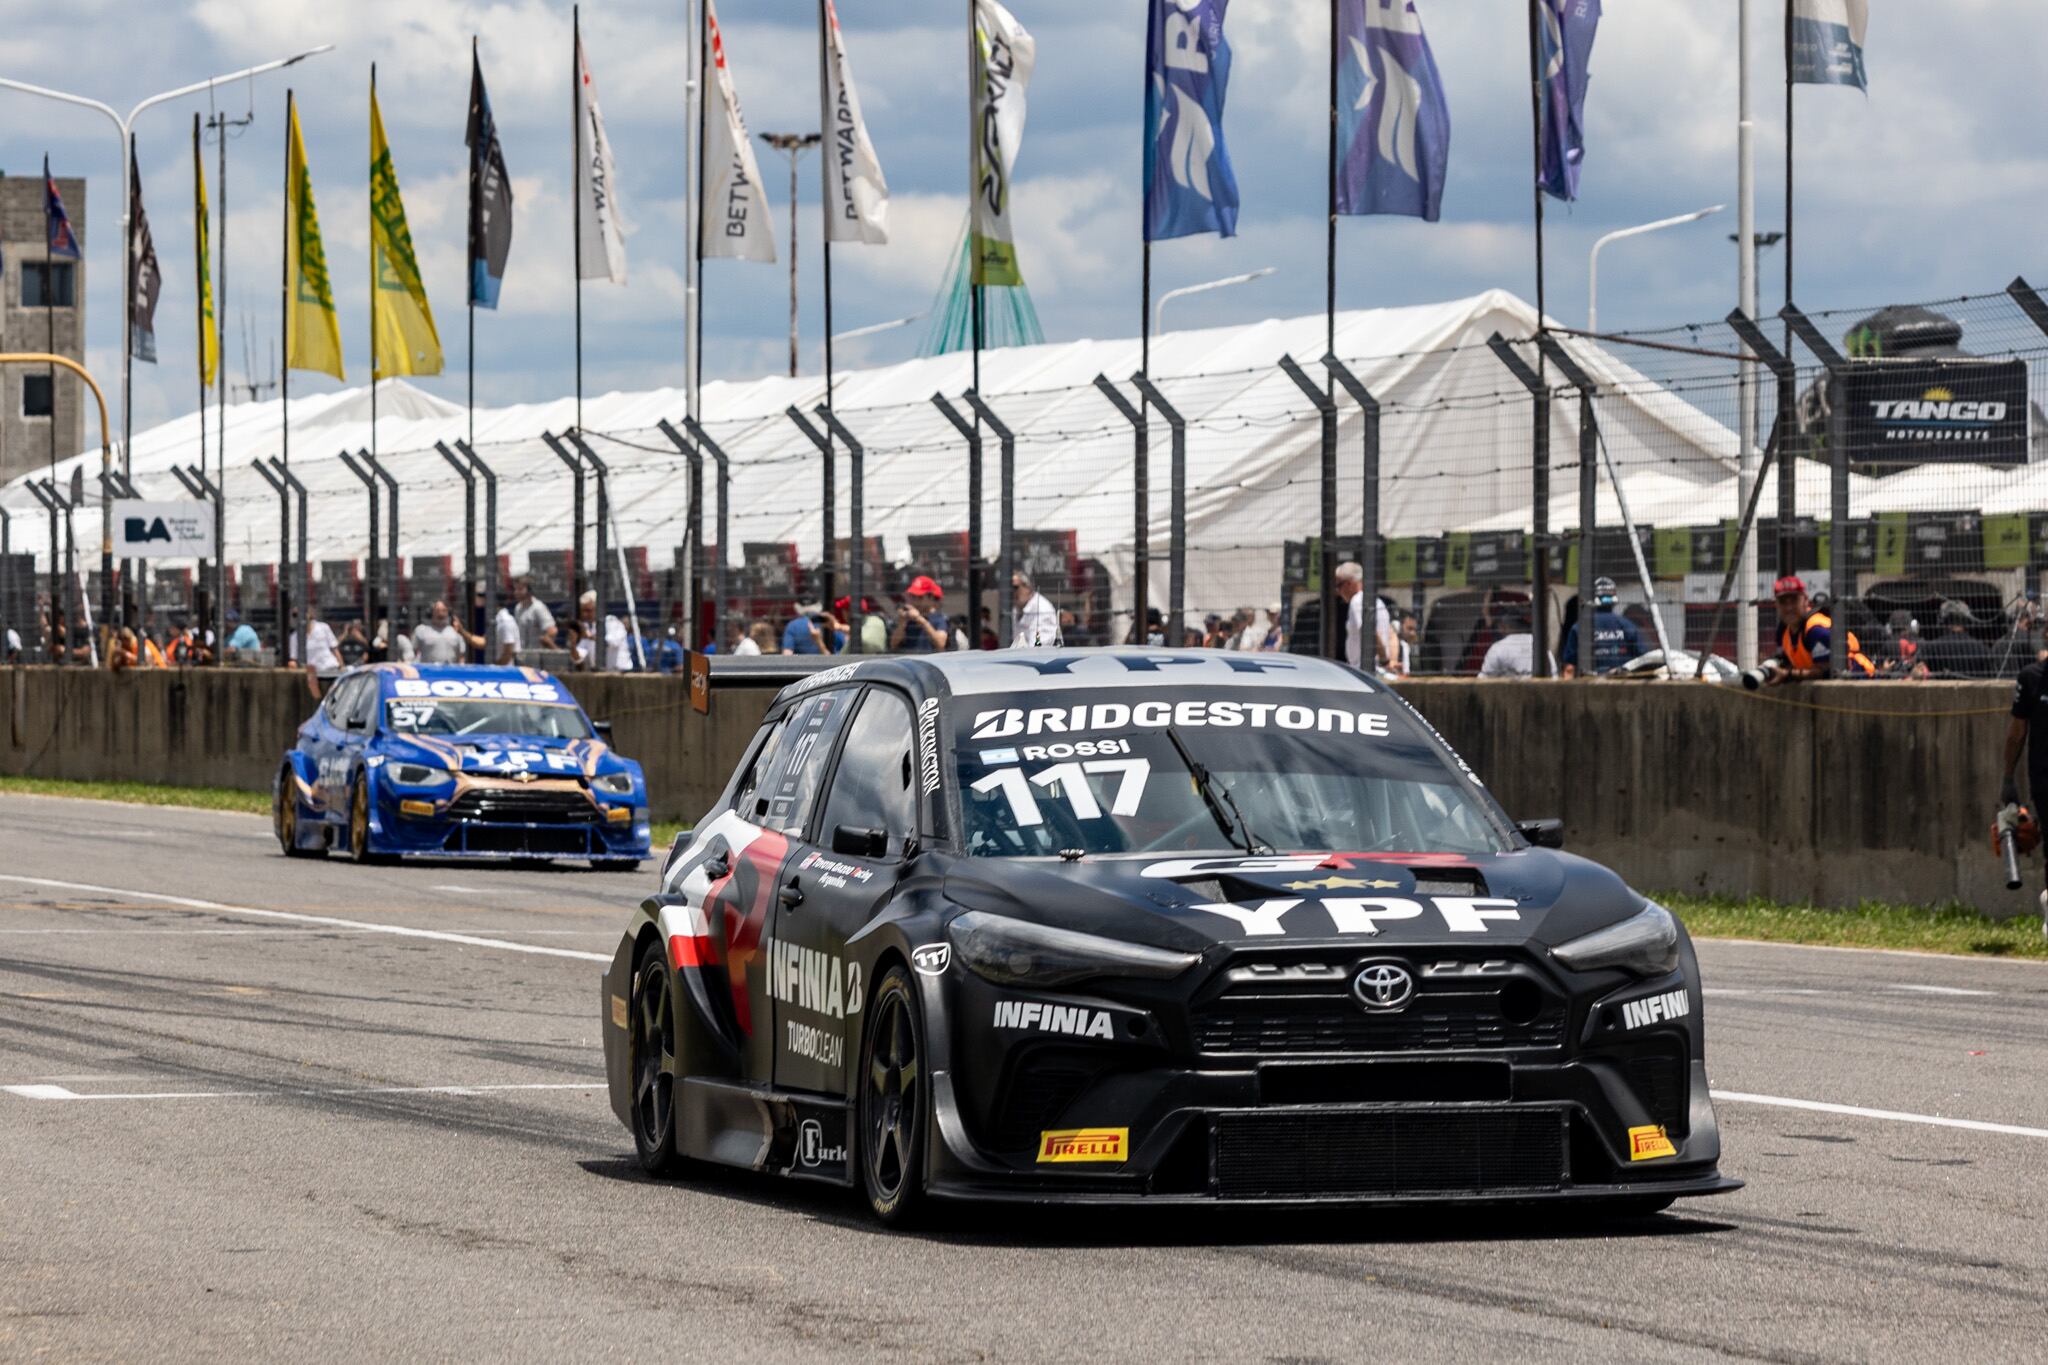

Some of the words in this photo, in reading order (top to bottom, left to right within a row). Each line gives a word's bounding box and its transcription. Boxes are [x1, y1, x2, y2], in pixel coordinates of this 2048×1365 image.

[1868, 400, 2007, 421] TANGO
[1886, 429, 1990, 442] MOTORSPORTS
[124, 516, 172, 543] BA
[996, 655, 1297, 675] YPF
[394, 680, 560, 701] BOXES
[391, 707, 435, 727] 57
[969, 701, 1391, 740] BRIDGESTONE
[464, 751, 579, 770] YPF
[785, 732, 820, 776] 117
[1022, 738, 1131, 761] ROSSI
[969, 757, 1152, 827] 117
[1188, 897, 1521, 936] YPF
[914, 948, 948, 967] 117
[765, 936, 844, 1020] INFINIA
[993, 1001, 1115, 1040] INFINIA
[1622, 988, 1690, 1031] INFINI
[1044, 1134, 1121, 1156] PIRELLI
